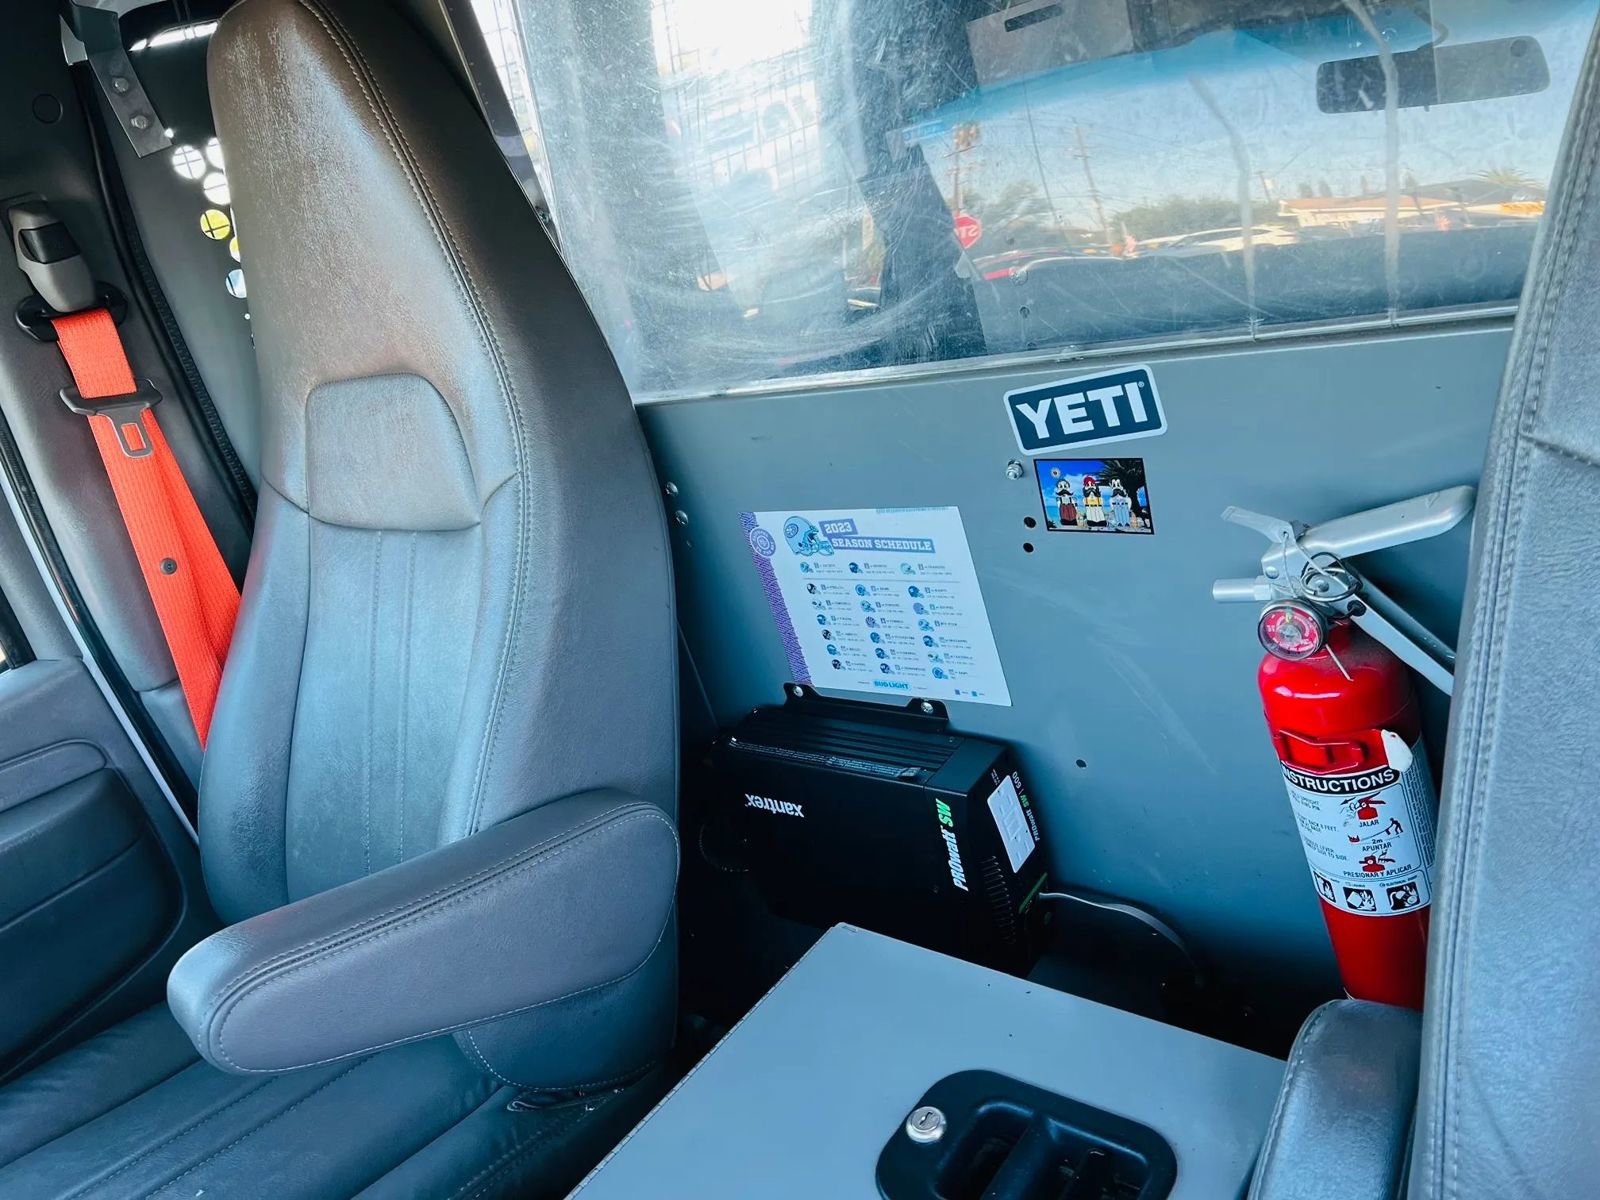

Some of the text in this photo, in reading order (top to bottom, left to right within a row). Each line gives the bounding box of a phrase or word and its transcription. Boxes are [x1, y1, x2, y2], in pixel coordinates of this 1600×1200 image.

[1015, 381, 1148, 440] YETI
[824, 521, 853, 534] 2023
[831, 537, 933, 551] SEASON SCHEDULE
[1011, 770, 1022, 790] 600
[744, 793, 805, 818] xantrex
[935, 797, 954, 828] SW
[1359, 819, 1380, 828] JALAR
[1362, 841, 1393, 852] APUNTAR
[1343, 870, 1379, 879] PRESIONAR
[1386, 864, 1412, 876] APLICAR
